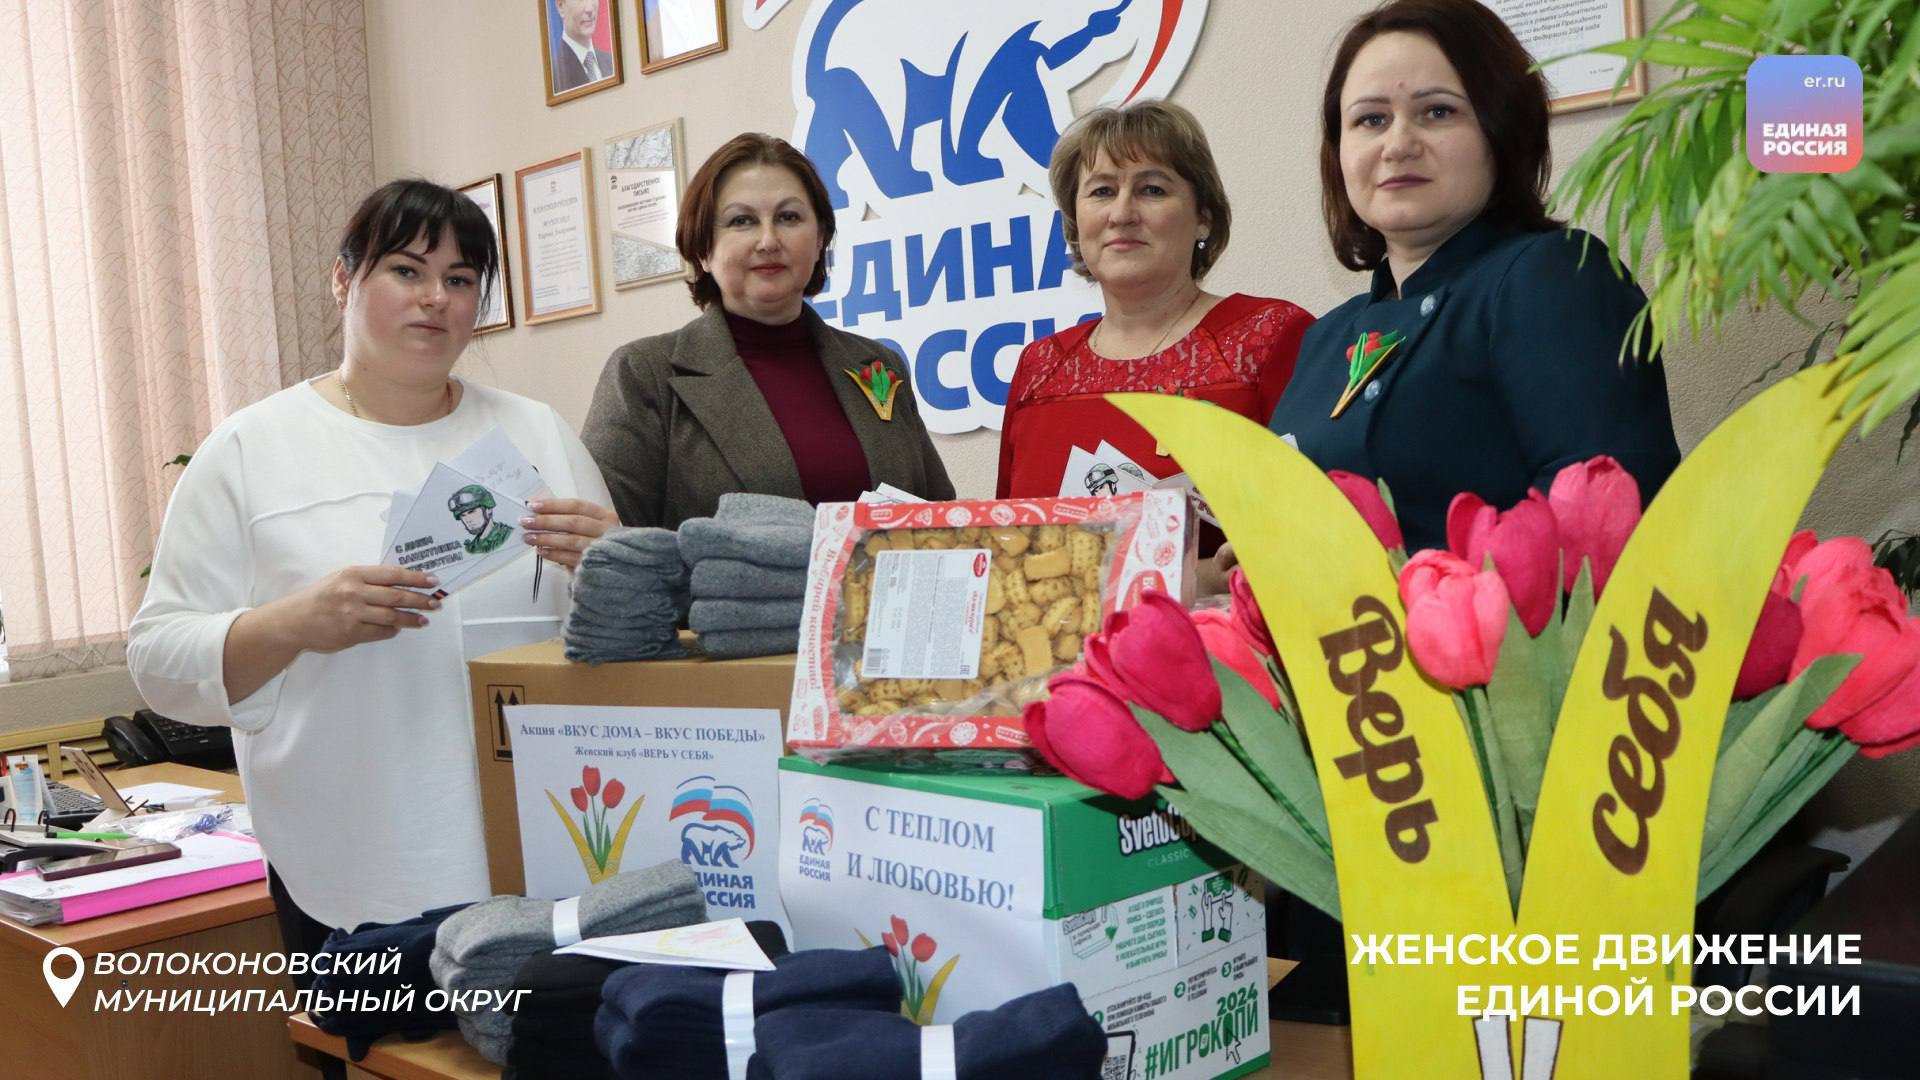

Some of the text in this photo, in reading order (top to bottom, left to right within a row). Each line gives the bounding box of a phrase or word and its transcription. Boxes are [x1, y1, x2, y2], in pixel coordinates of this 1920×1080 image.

[520, 724, 555, 737] Акция
[558, 725, 598, 738] «ВКУС
[602, 726, 642, 740] ДОМА
[655, 727, 692, 741] ВКУС
[695, 728, 766, 744] ПОБЕДЫ»
[1318, 594, 1439, 864] Верь
[1592, 587, 1708, 876] себя
[574, 745, 613, 758] Женский
[615, 747, 637, 760] клуб
[639, 748, 669, 760] «ВЕРЬ
[681, 750, 714, 761] СЕБЯ»
[865, 806, 995, 853] С ТЕПЛОМ
[800, 855, 831, 869] ЕДИНАЯ
[800, 866, 831, 882] РОССИЯ
[847, 852, 1014, 911] И ЛЮБОВЬЮ!
[705, 890, 756, 909] ССИЯ
[1216, 982, 1259, 1017] 2024
